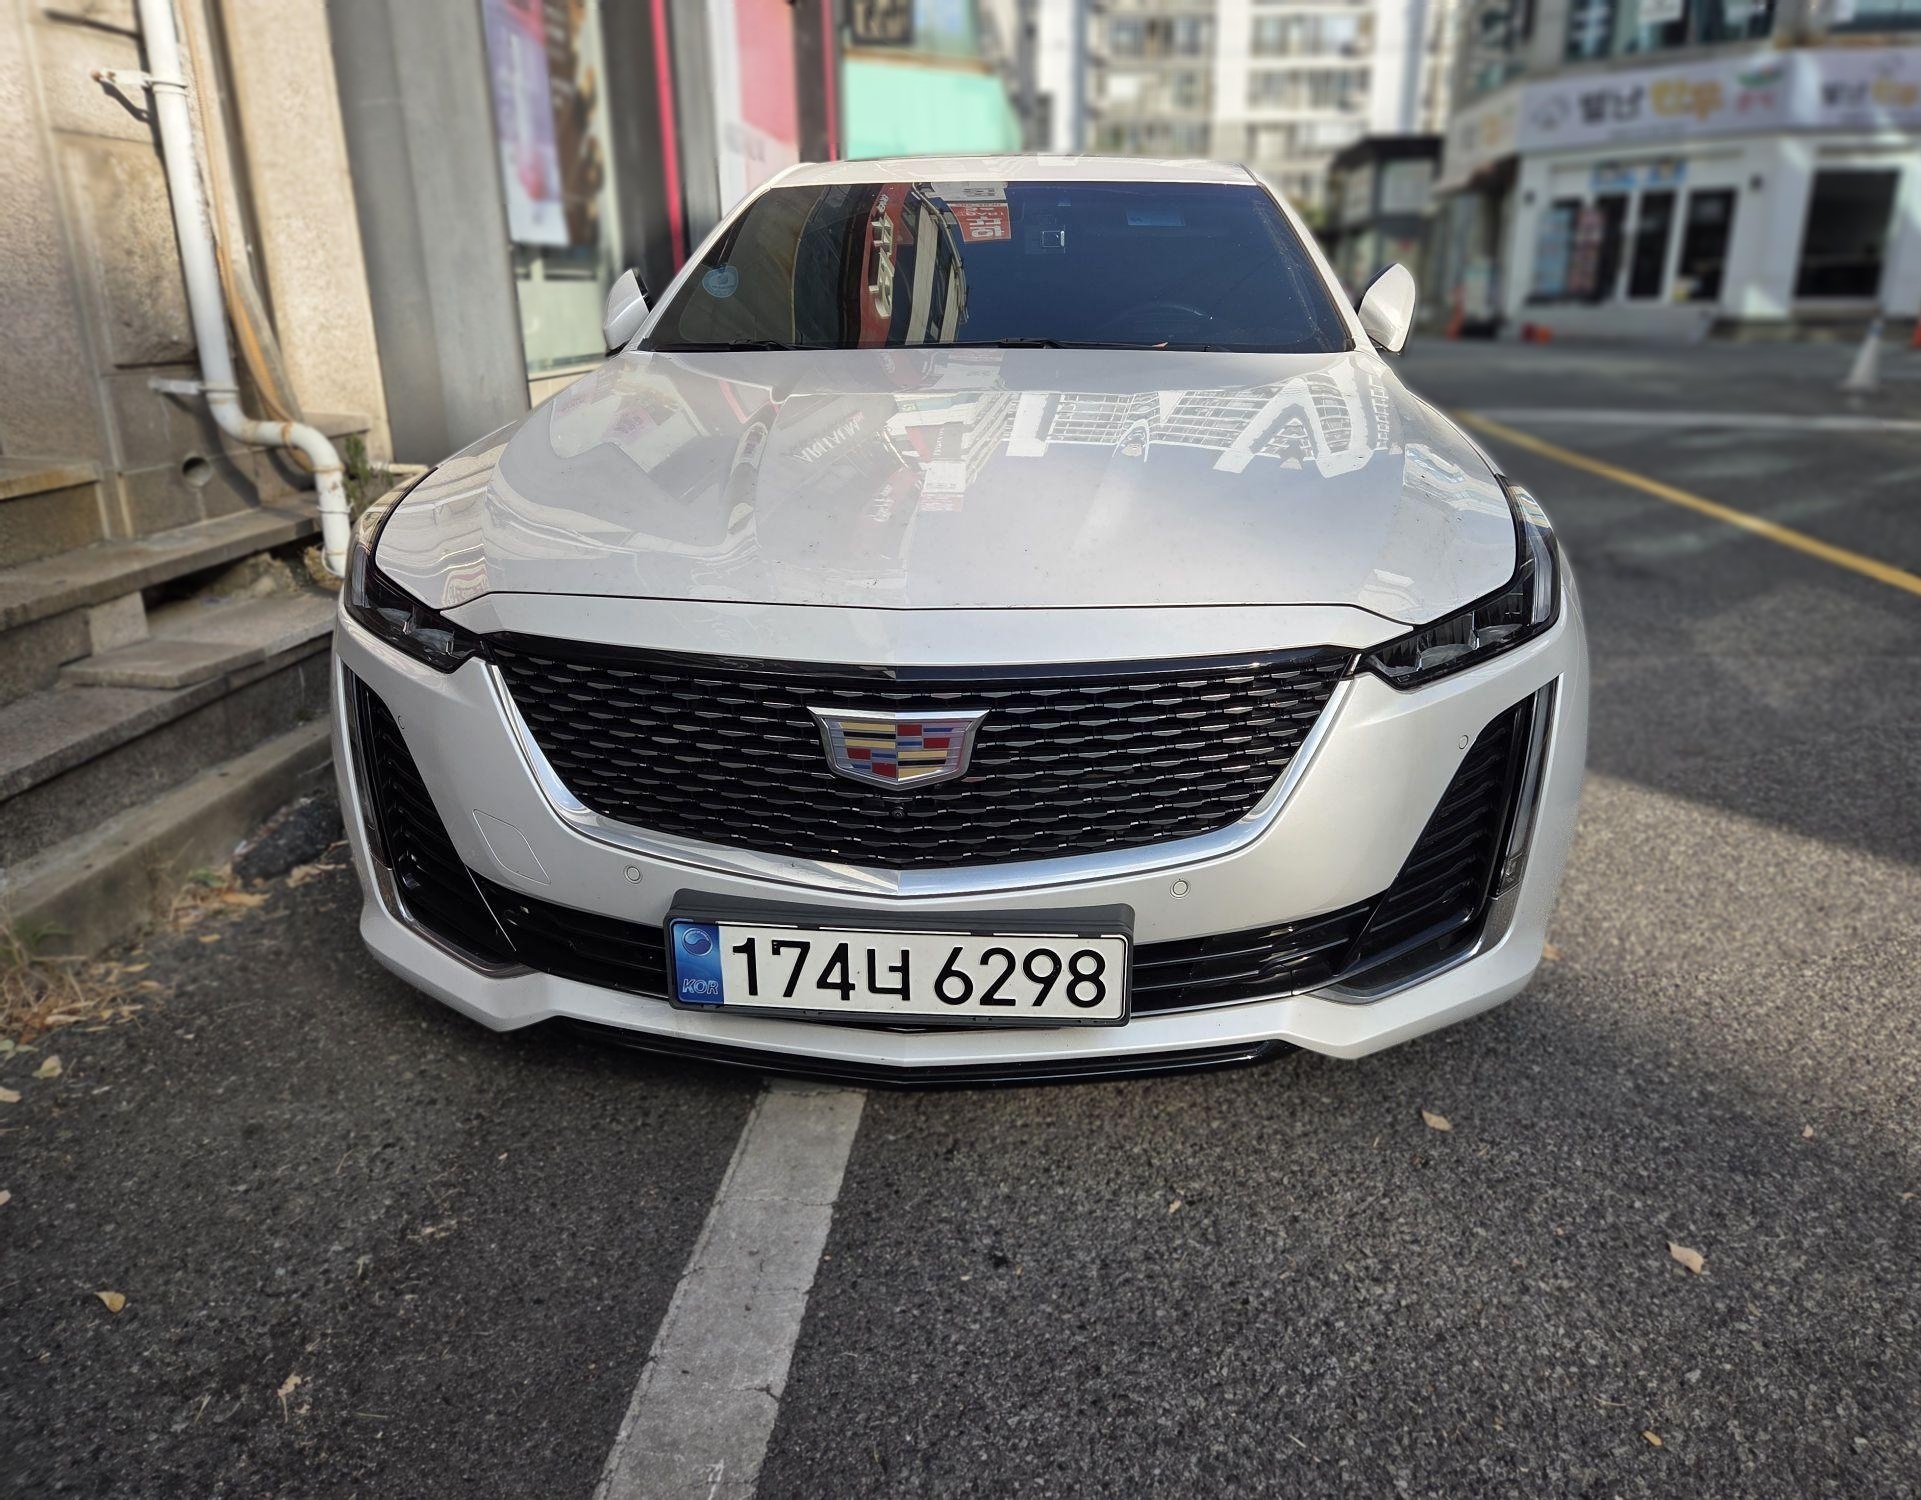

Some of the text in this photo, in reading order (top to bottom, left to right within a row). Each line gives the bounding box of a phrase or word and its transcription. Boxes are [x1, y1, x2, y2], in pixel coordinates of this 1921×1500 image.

[682, 978, 719, 995] KOR
[732, 937, 1107, 1008] 174너 6298
